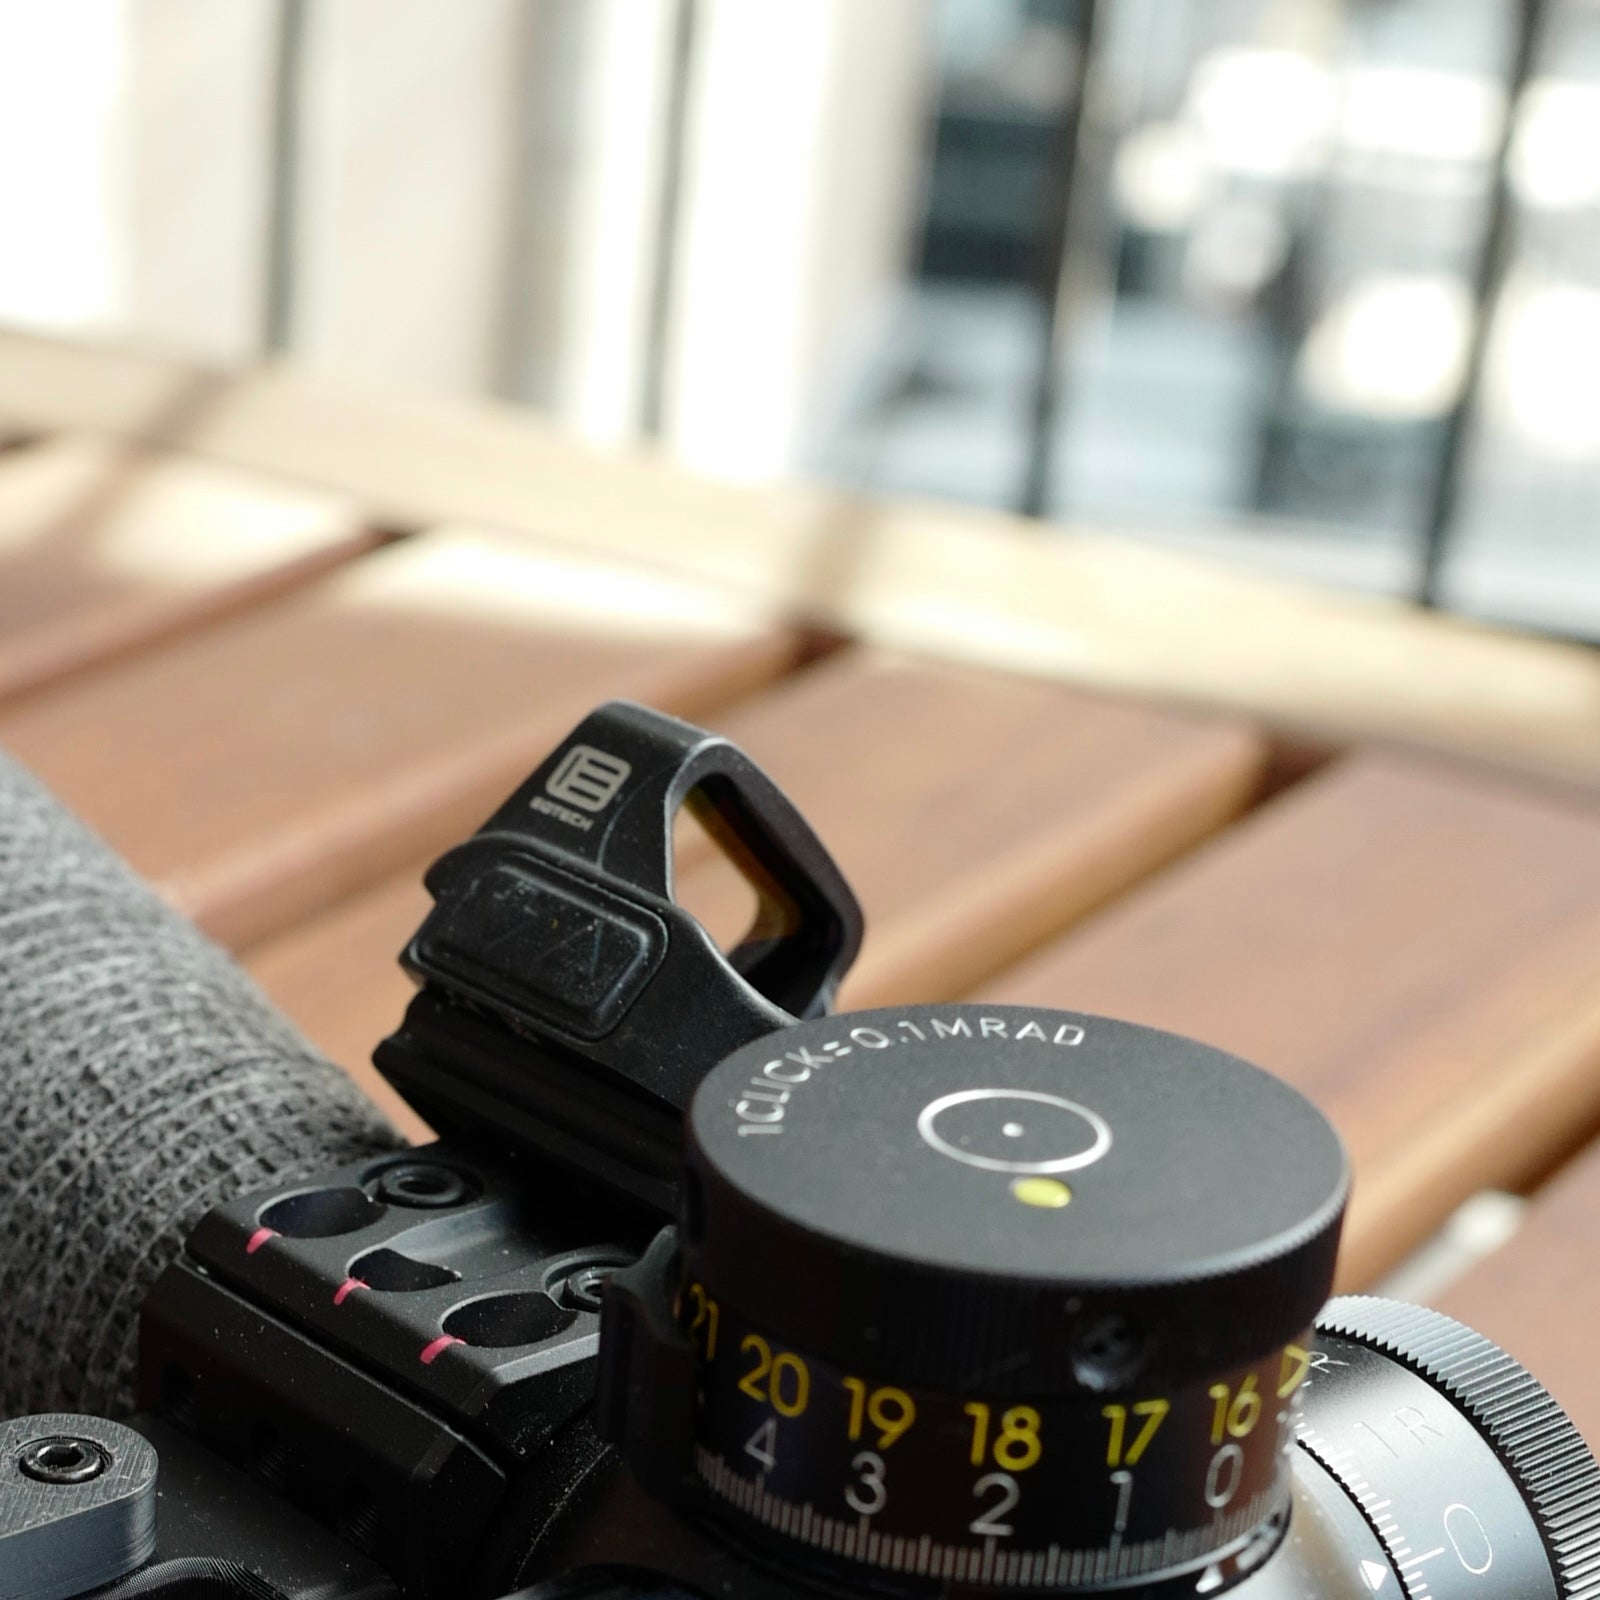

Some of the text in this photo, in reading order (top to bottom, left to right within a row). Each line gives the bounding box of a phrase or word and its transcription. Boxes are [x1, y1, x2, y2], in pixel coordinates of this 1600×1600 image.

[737, 1333, 811, 1418] 20
[842, 1376, 916, 1450] 19
[964, 1402, 1042, 1471] 18
[1101, 1399, 1170, 1467] 17
[1208, 1372, 1262, 1446] 16
[744, 1418, 1244, 1537] 4 3 2 1 0
[1443, 1503, 1493, 1575] 0
